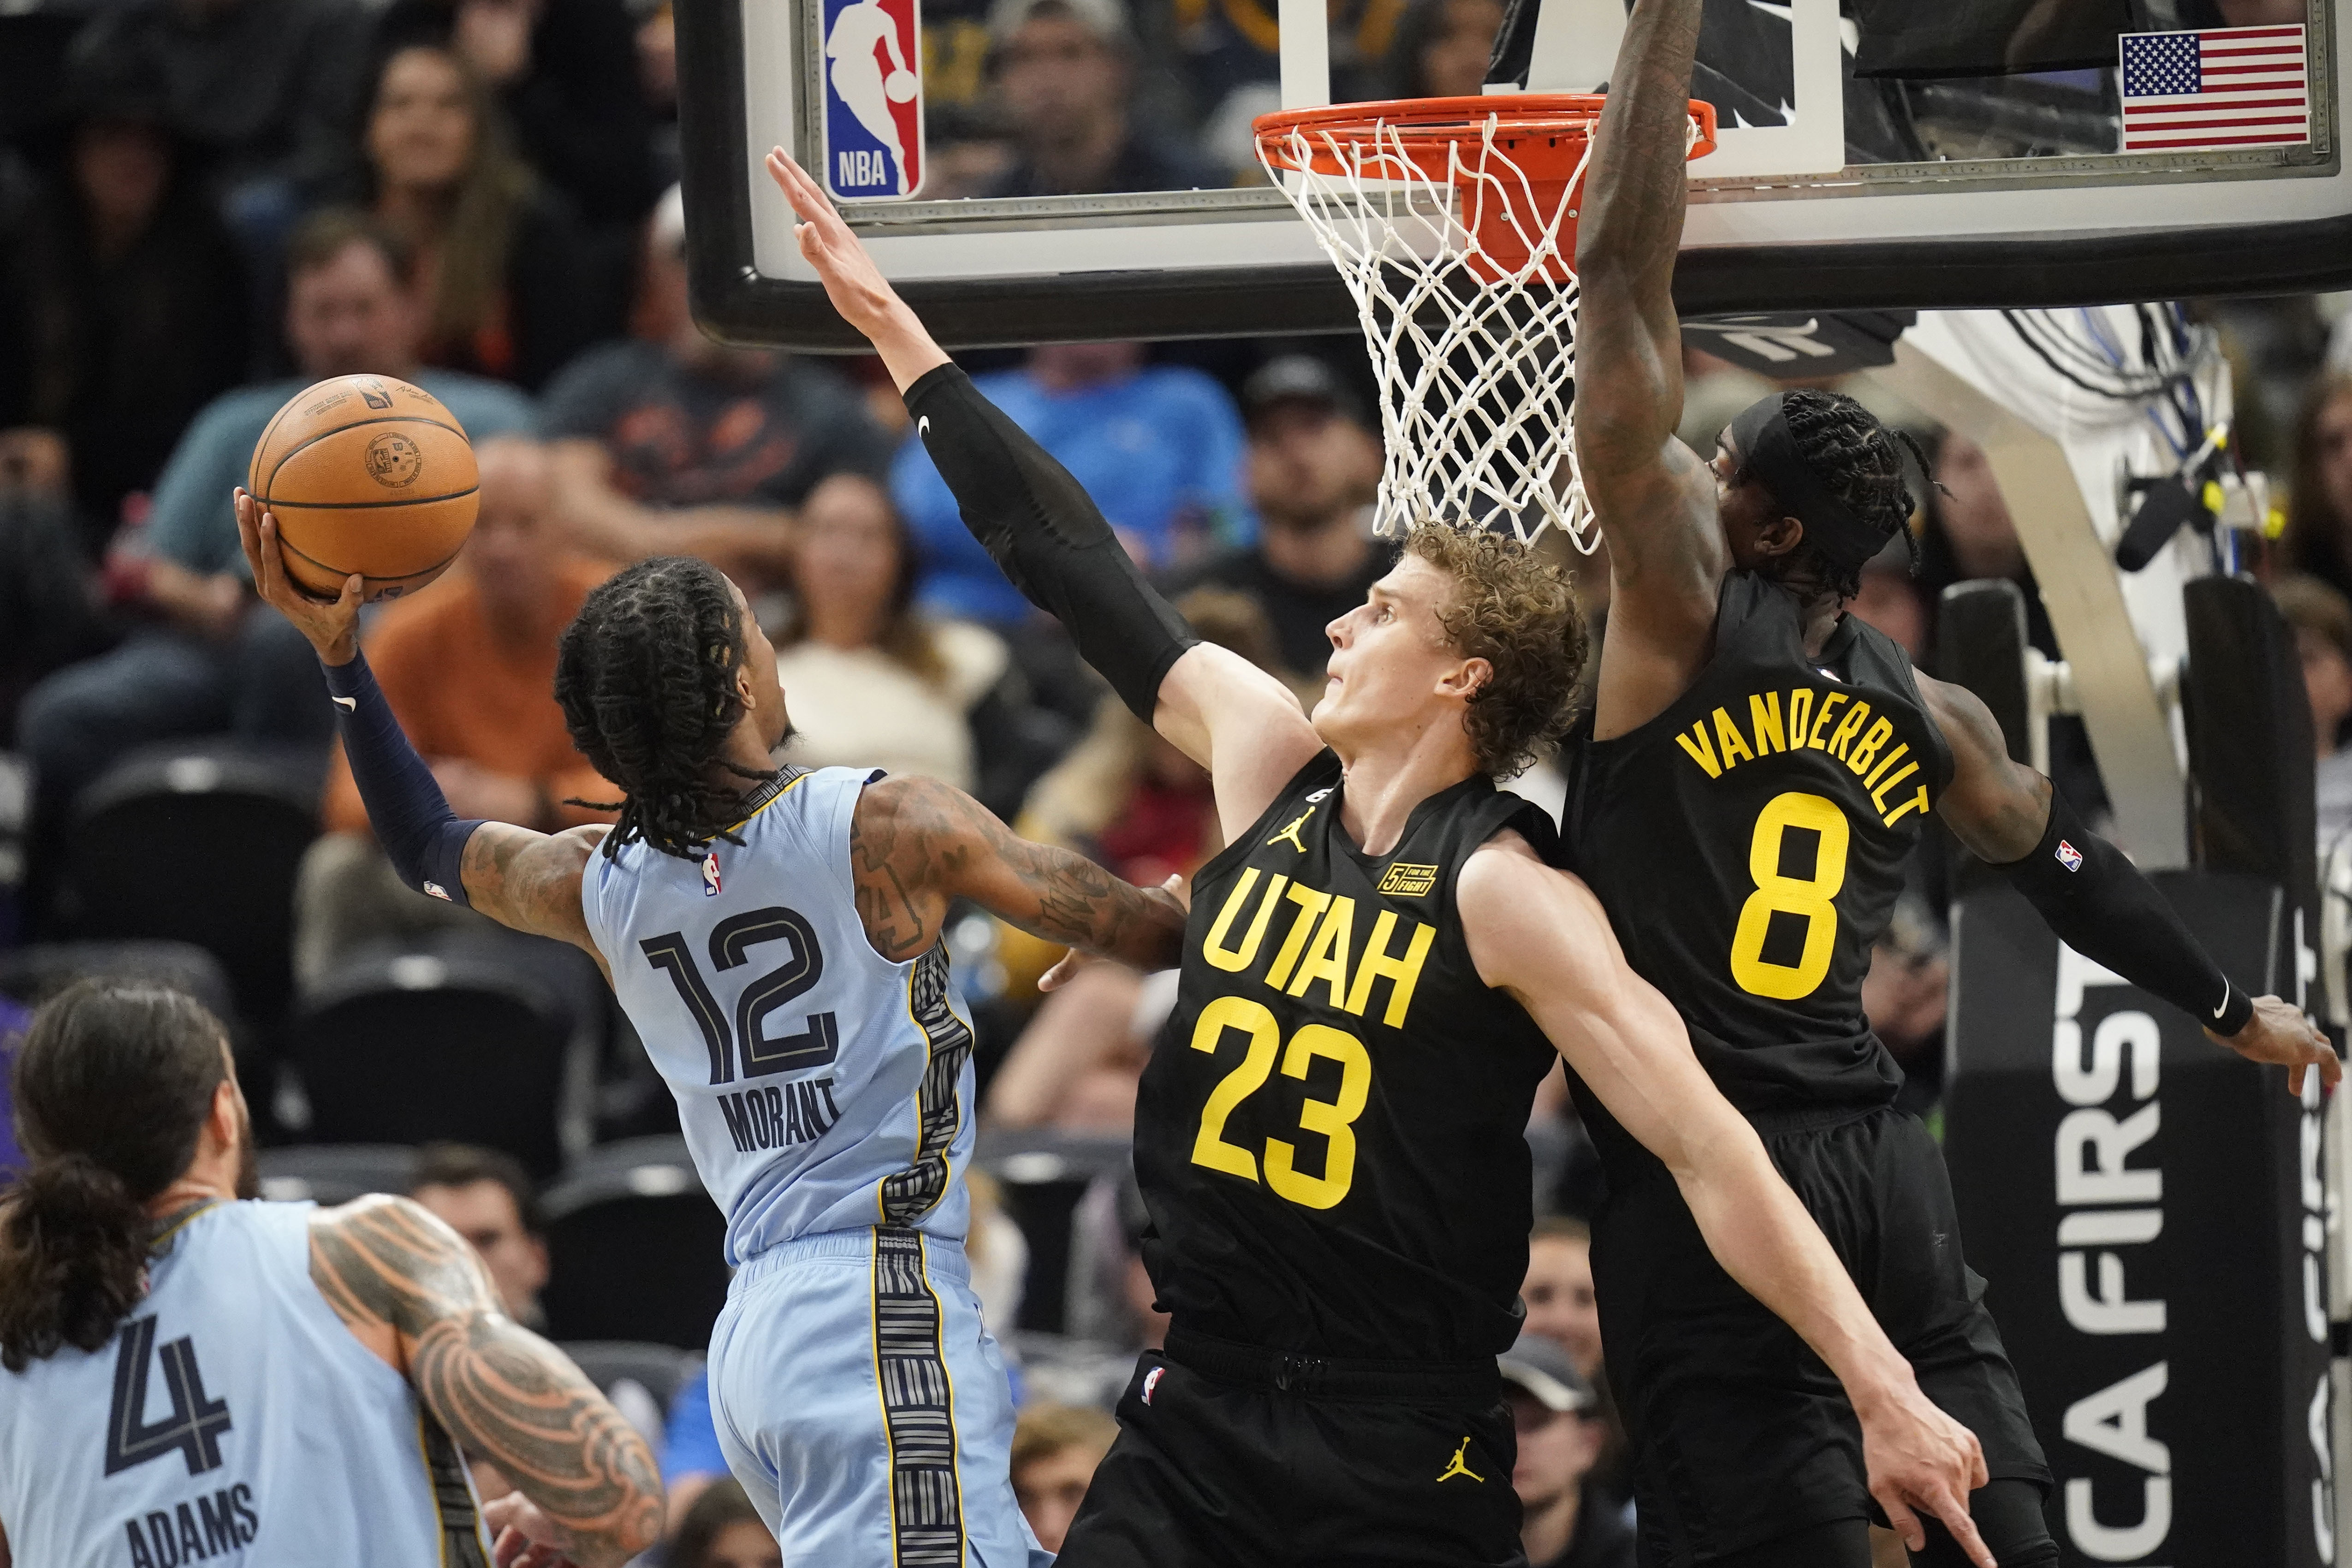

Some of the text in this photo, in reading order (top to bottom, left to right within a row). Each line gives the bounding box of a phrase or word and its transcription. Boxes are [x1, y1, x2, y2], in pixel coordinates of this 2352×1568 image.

[839, 150, 887, 187] NBA
[1305, 787, 1335, 803] 6
[1675, 688, 1930, 828] VANDERBILT
[706, 886, 716, 895] NBA
[1383, 867, 1405, 891] 5
[1397, 881, 1429, 891] FIGHT
[1731, 792, 1849, 1000] 8
[639, 906, 839, 1085] 12
[1203, 867, 1437, 1029] UTAH
[717, 1077, 843, 1152] MORANT
[1190, 996, 1372, 1210] 23
[104, 1314, 233, 1477] 4
[2063, 1360, 2172, 1568] CA
[125, 1482, 258, 1568] ADAMS
